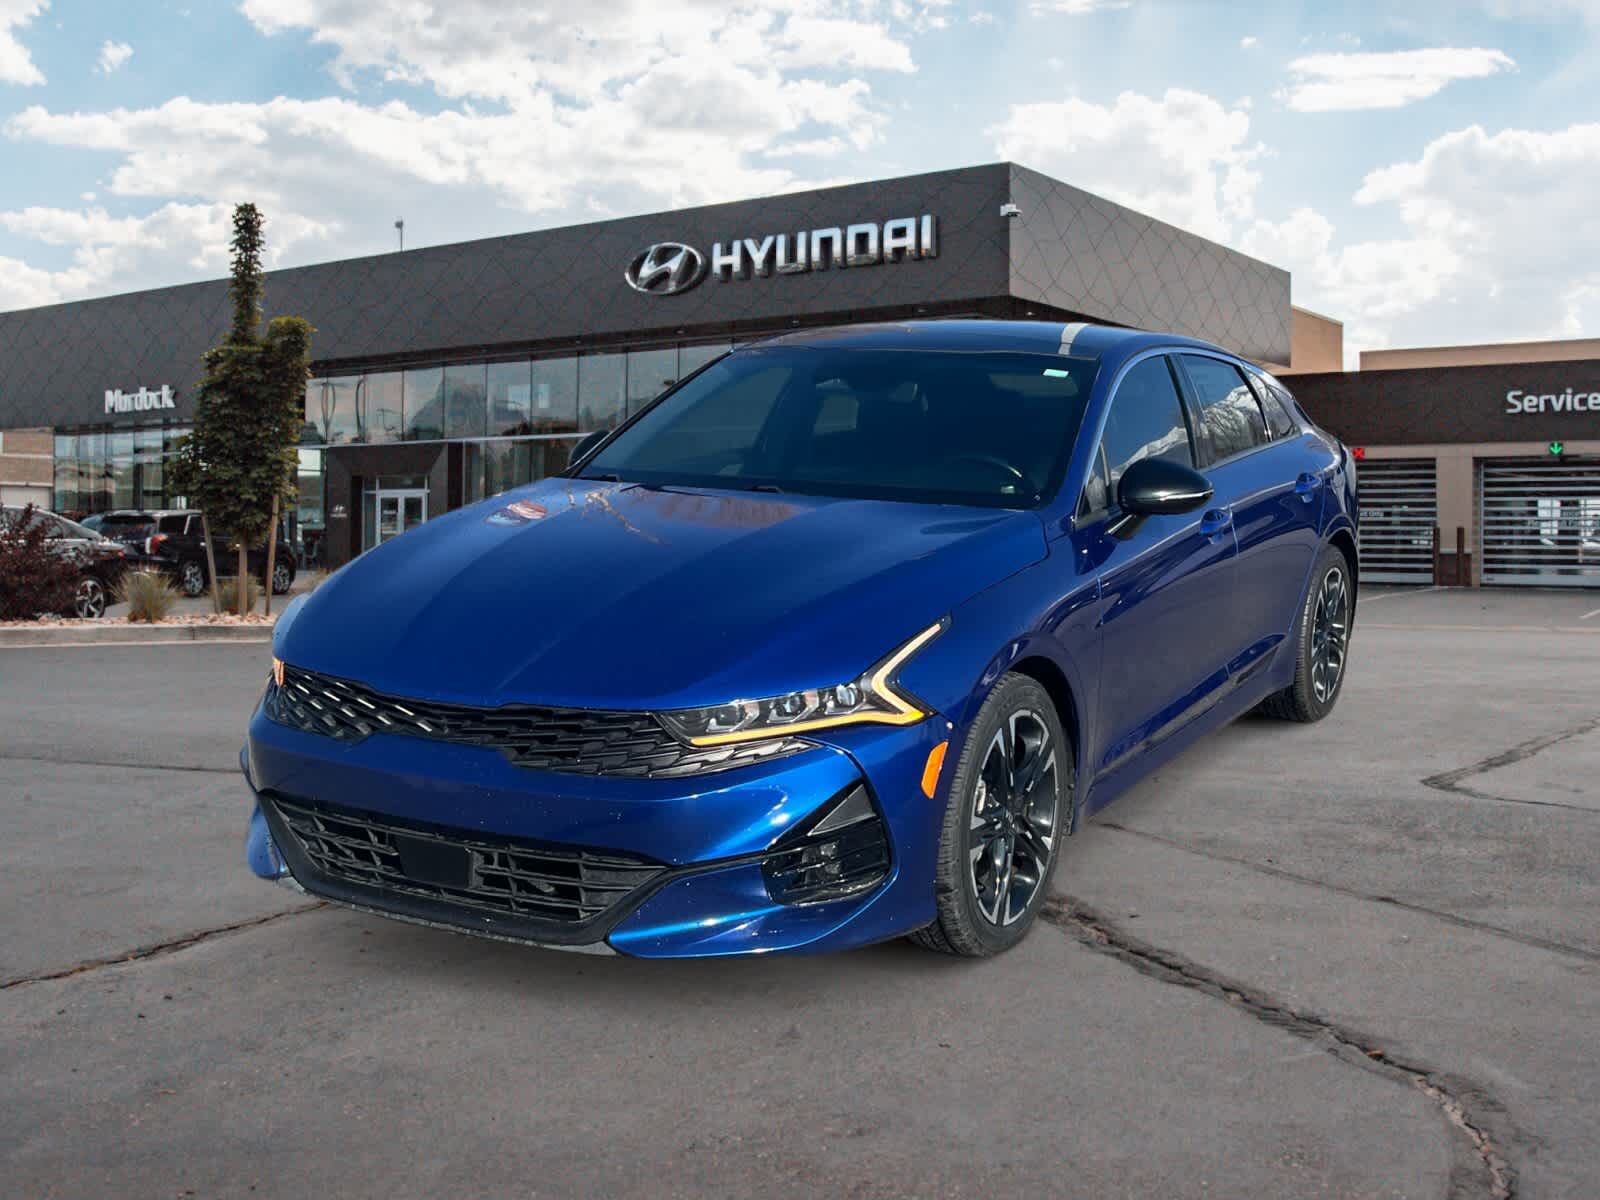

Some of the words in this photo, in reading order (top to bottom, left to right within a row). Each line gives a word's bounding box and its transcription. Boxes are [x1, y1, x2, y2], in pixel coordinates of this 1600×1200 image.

[711, 214, 937, 282] HYUNDAI
[104, 384, 176, 414] Murdock
[1506, 387, 1600, 413] Service
